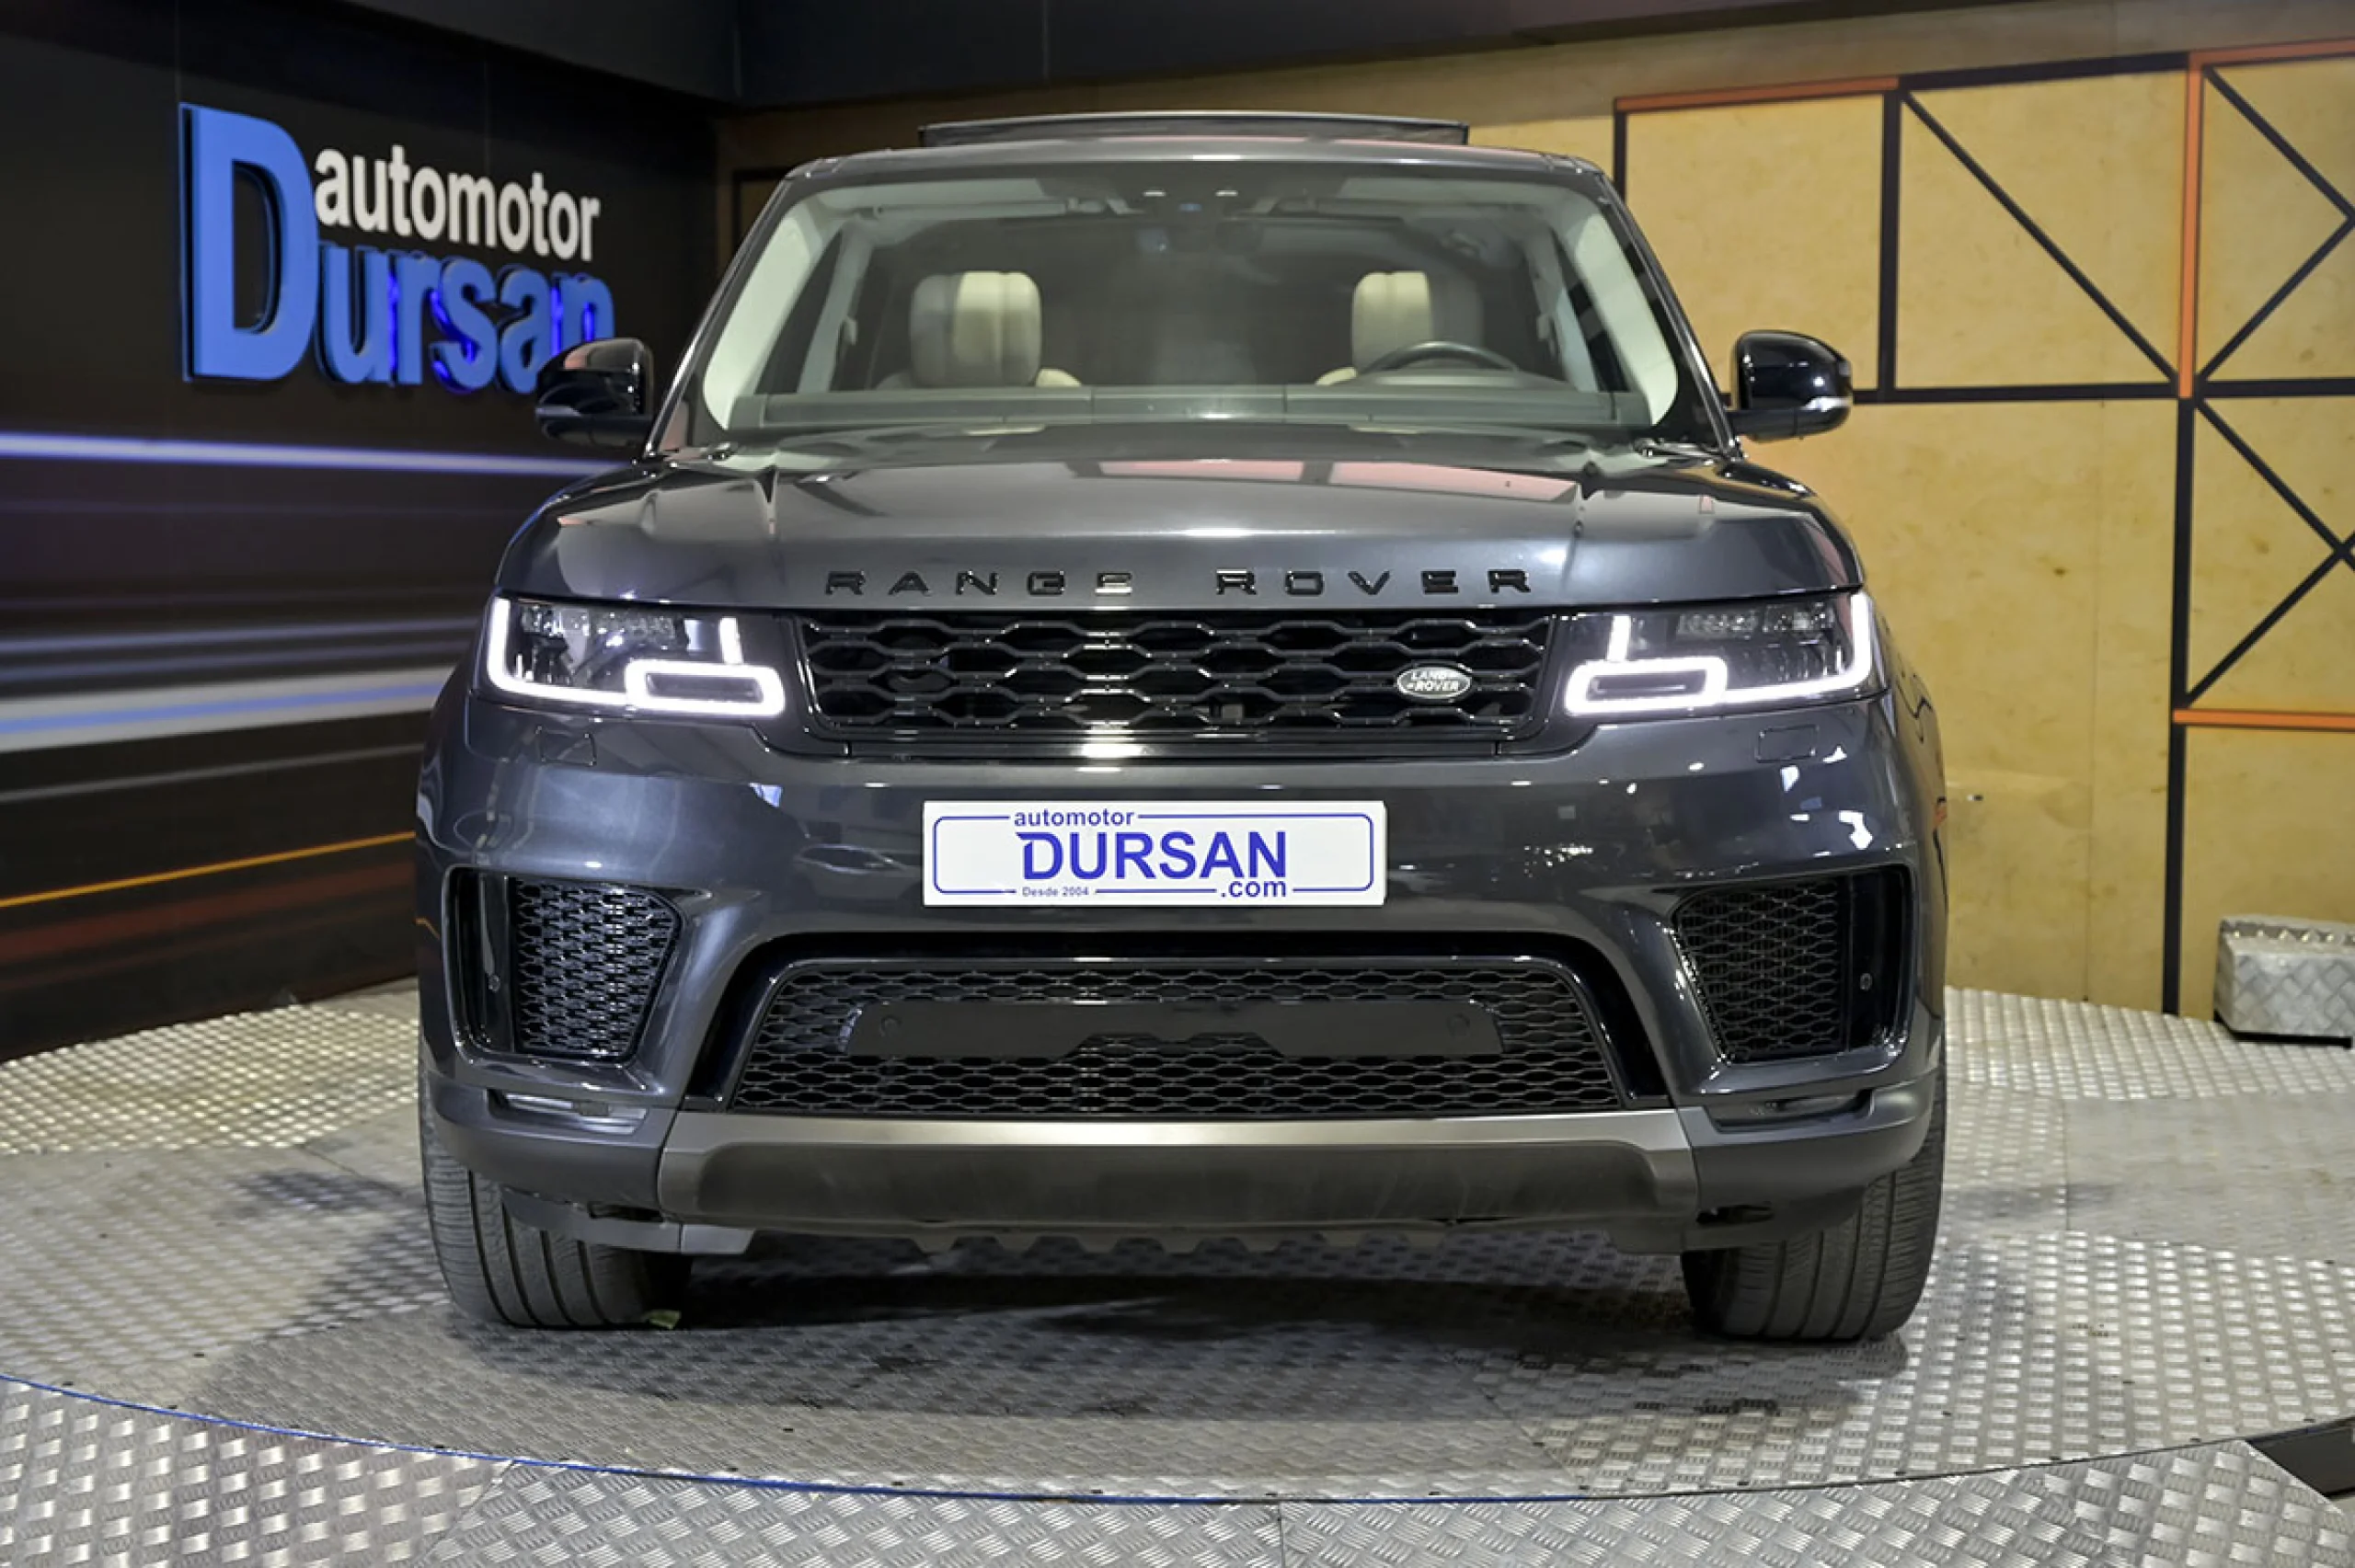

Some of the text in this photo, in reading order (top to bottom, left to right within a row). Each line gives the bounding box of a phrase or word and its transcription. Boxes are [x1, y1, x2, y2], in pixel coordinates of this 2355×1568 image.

[315, 144, 601, 261] automotor
[825, 569, 1532, 596] RANGE ROVER
[1015, 808, 1134, 827] automotor
[1015, 831, 1287, 880] DURSAN
[1022, 886, 1089, 898] Desde 2004
[1220, 879, 1287, 898] .com
